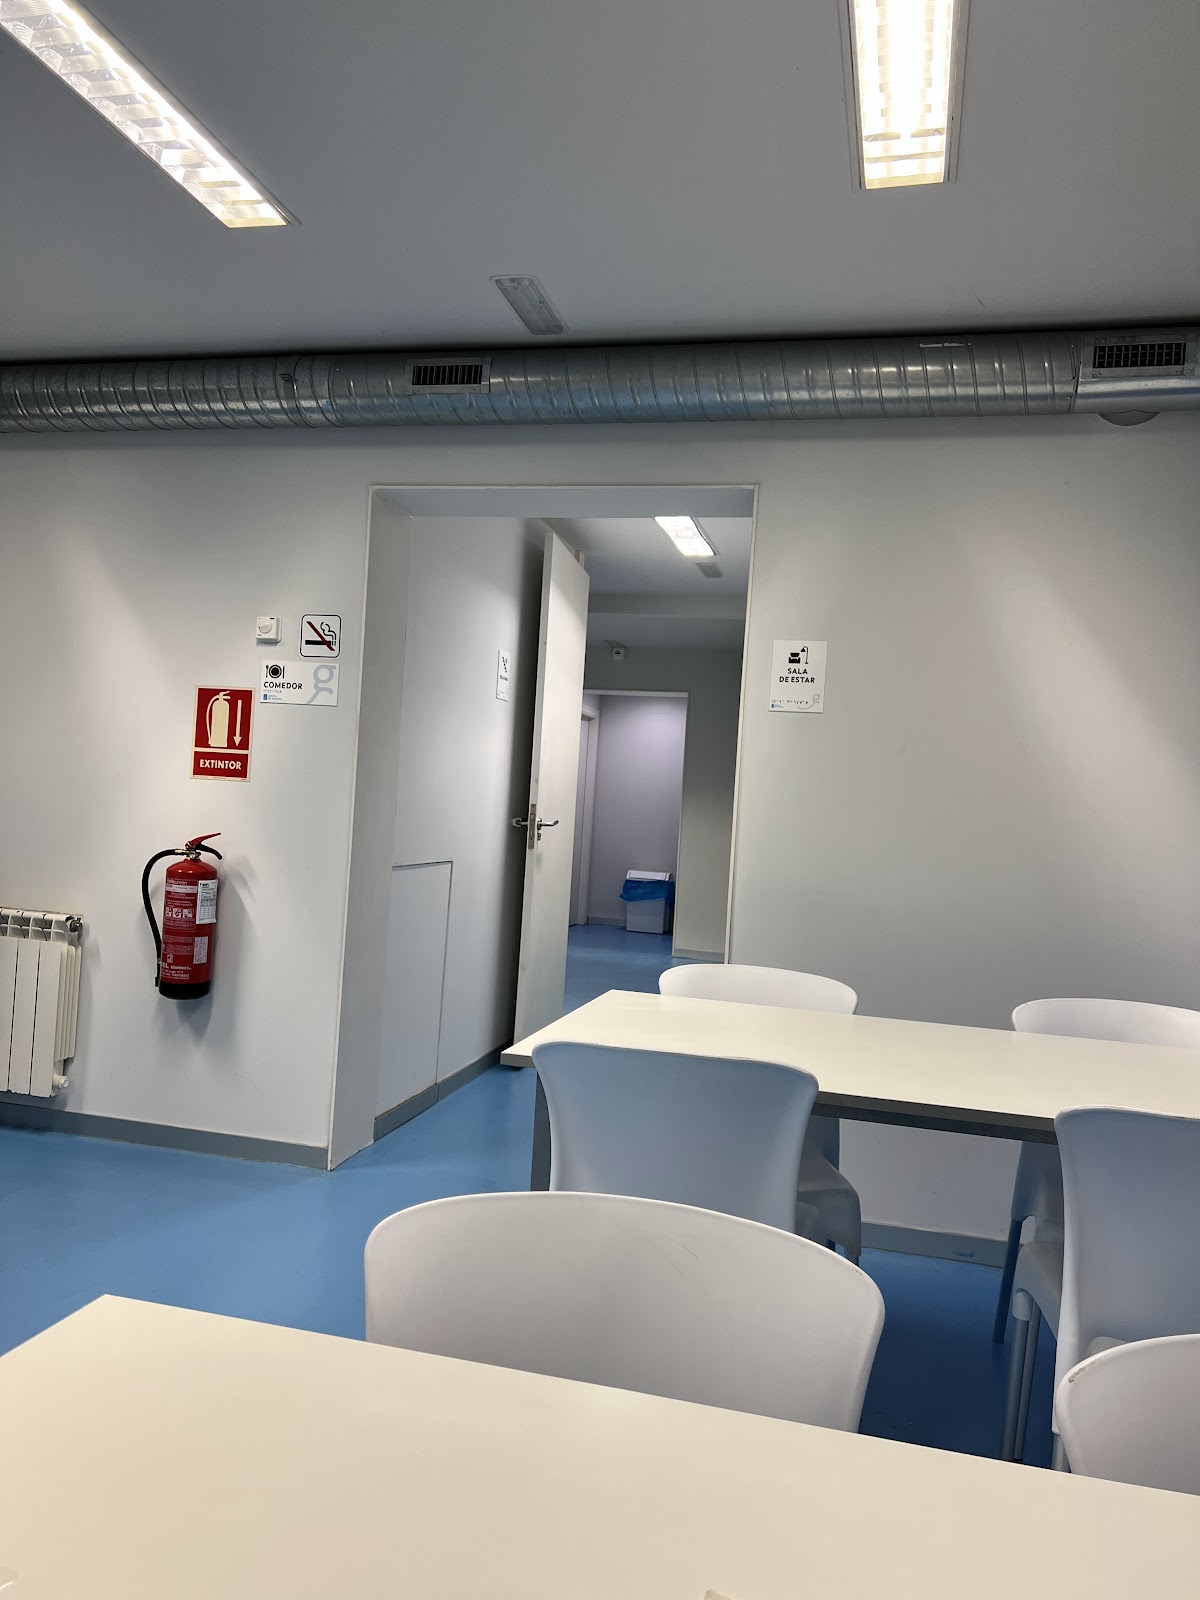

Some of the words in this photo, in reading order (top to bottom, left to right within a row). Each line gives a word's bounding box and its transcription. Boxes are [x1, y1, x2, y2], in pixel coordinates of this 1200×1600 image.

[787, 667, 808, 675] SALA
[790, 676, 815, 684] ESTAR
[263, 681, 303, 690] COMEDOR
[199, 758, 242, 771] EXTINTOR
